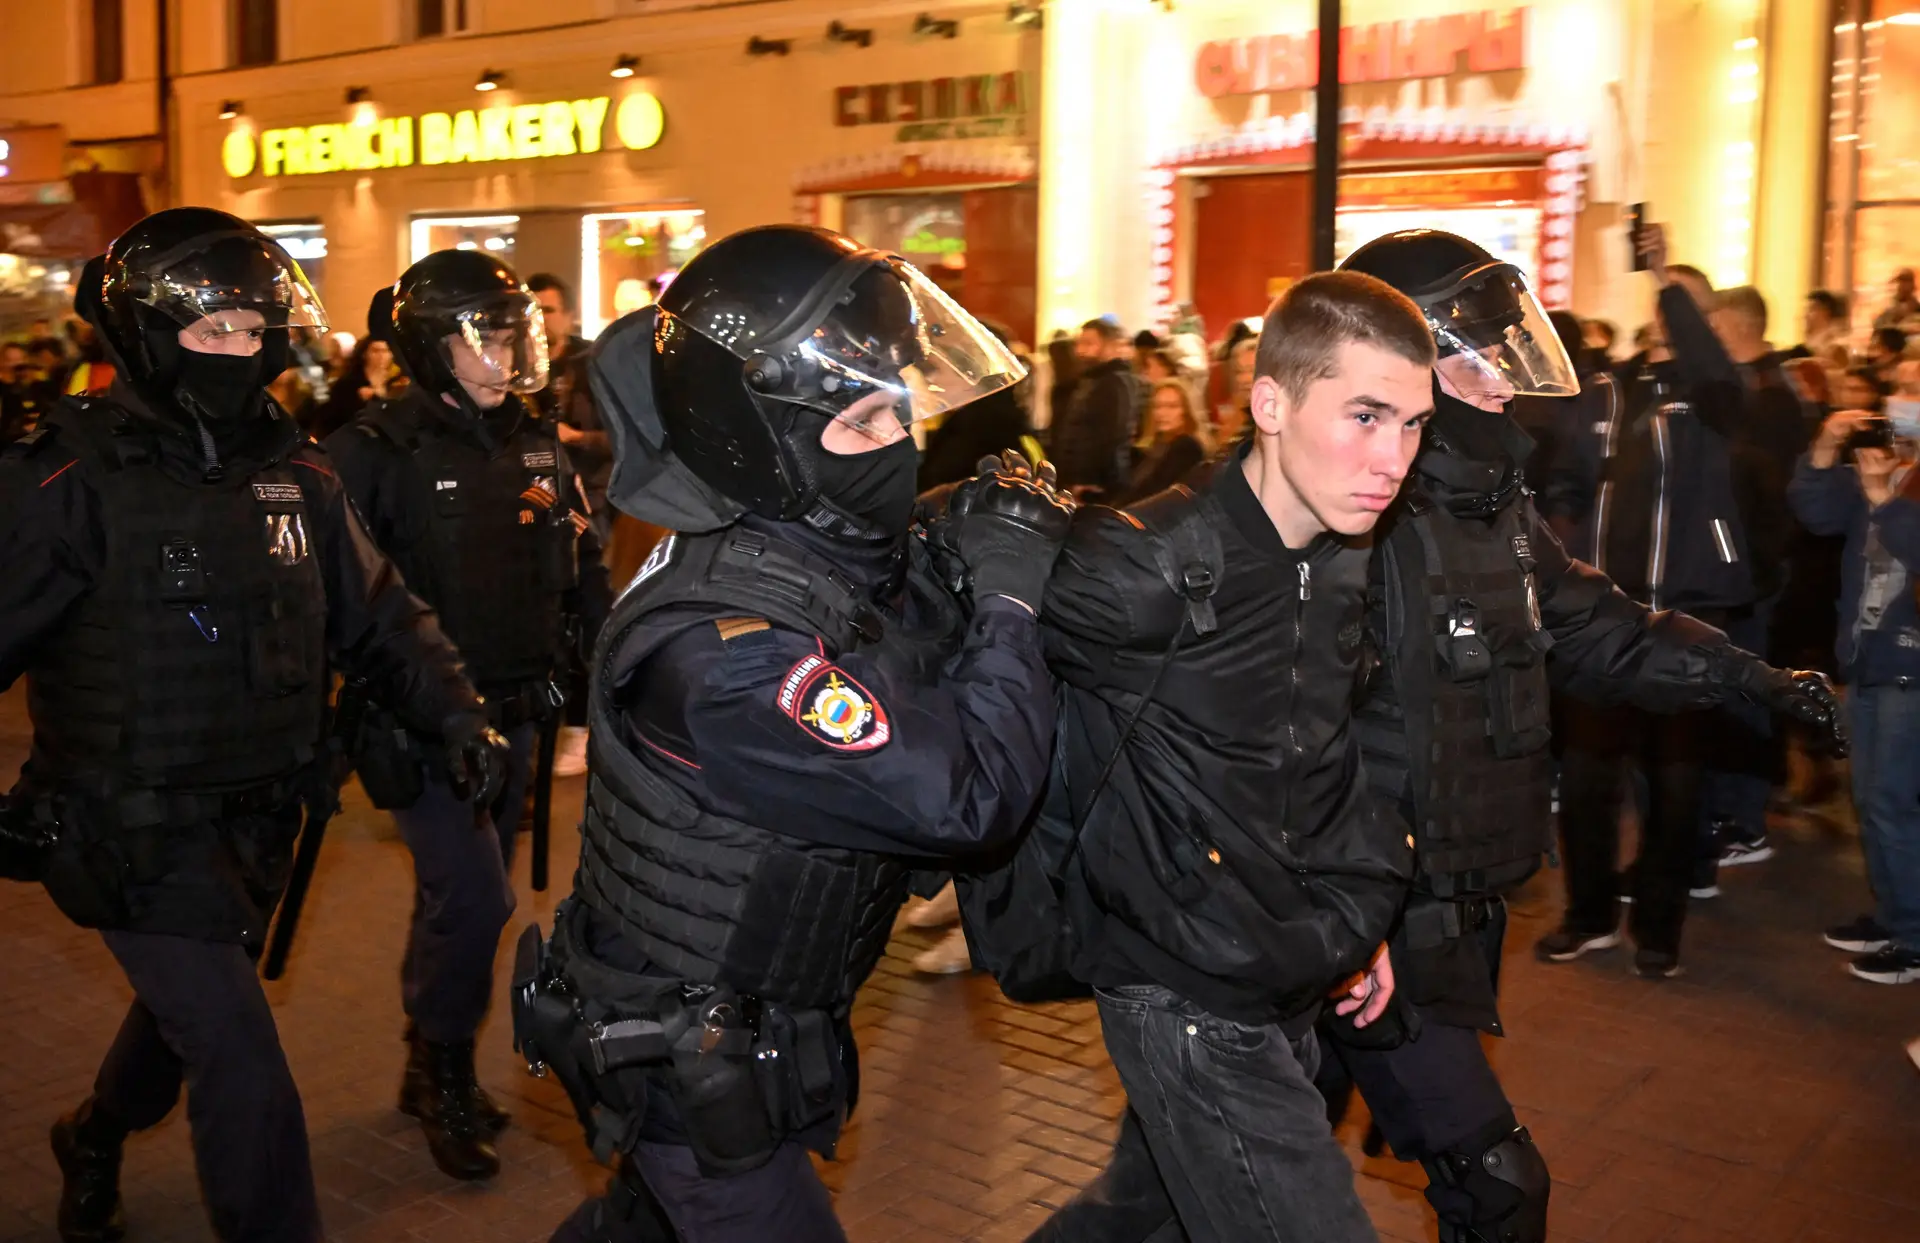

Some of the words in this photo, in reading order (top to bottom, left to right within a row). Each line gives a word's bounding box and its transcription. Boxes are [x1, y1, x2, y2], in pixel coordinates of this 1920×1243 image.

[262, 116, 414, 177] FRENCH
[420, 97, 610, 165] BAKERY
[781, 657, 822, 710] ПОЛИЦИЯ
